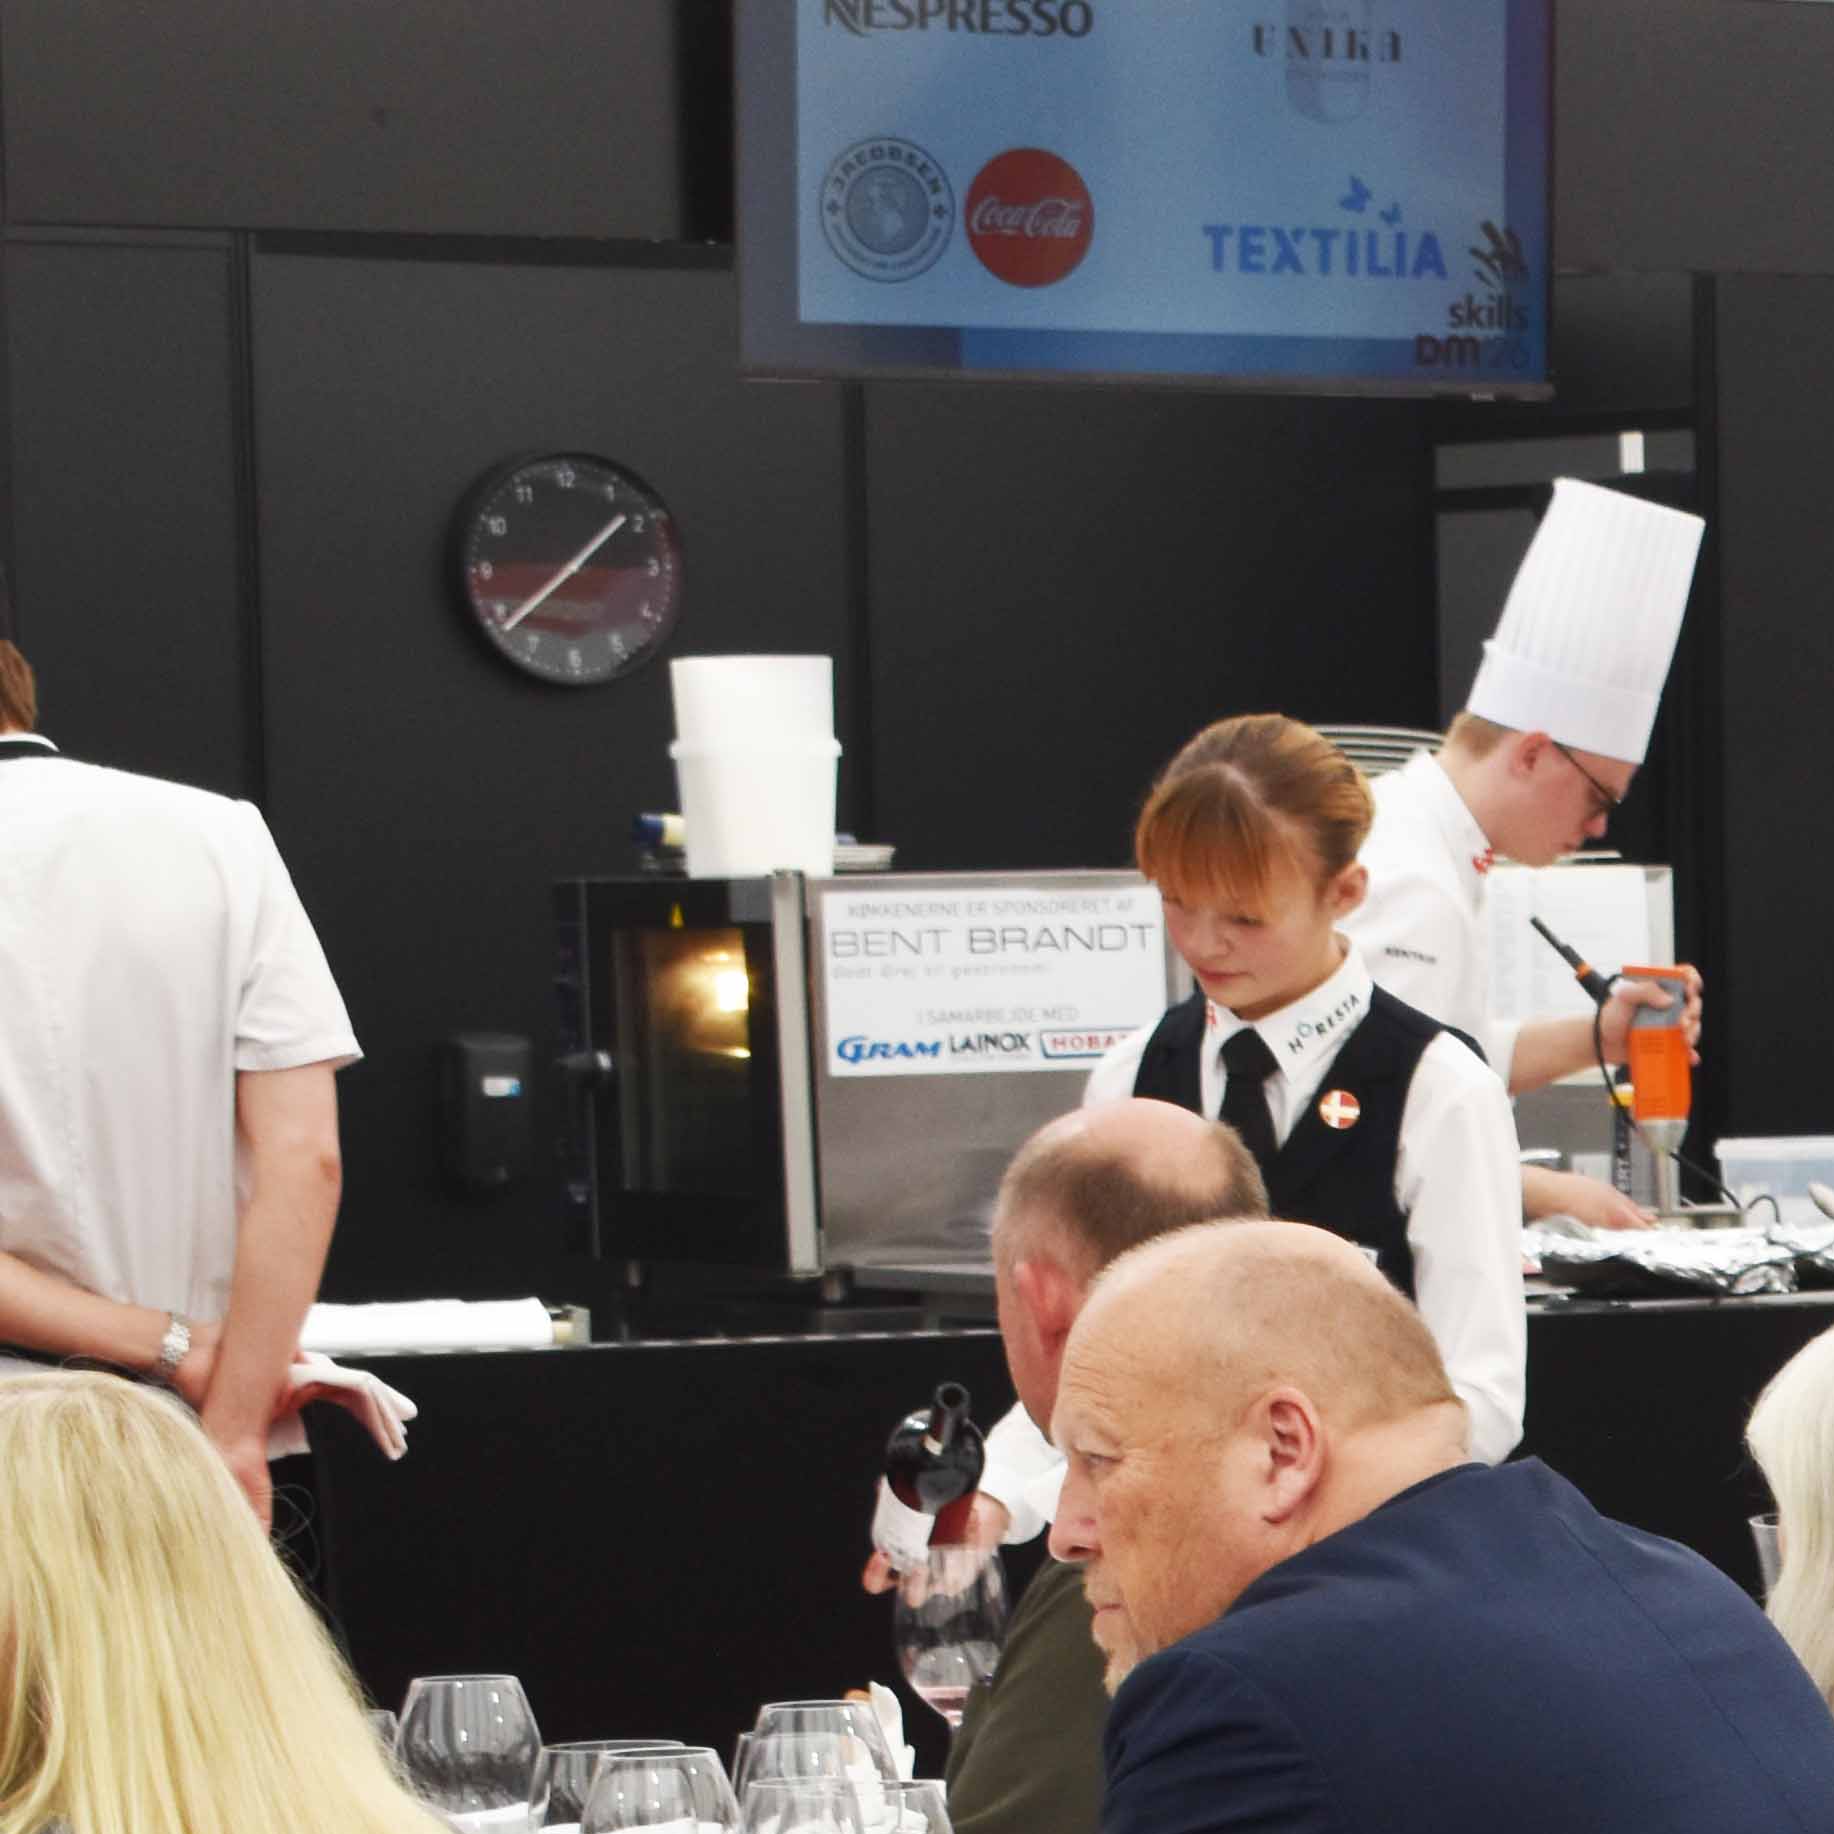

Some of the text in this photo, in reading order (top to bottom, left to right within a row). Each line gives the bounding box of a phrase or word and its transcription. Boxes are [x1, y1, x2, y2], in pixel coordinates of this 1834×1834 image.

[1202, 224, 1449, 280] TEXTILIA
[1448, 294, 1532, 331] skills
[556, 468, 577, 489] 12
[516, 485, 534, 502] 11
[605, 484, 616, 501] 1
[487, 516, 507, 536] 10
[631, 514, 645, 534] 2
[479, 561, 494, 581] 9
[648, 557, 660, 578] 3
[527, 634, 541, 653] 7
[567, 648, 583, 668] 6
[831, 922, 1156, 958] BENT BRANDT
[1051, 1034, 1128, 1050] HOBA
